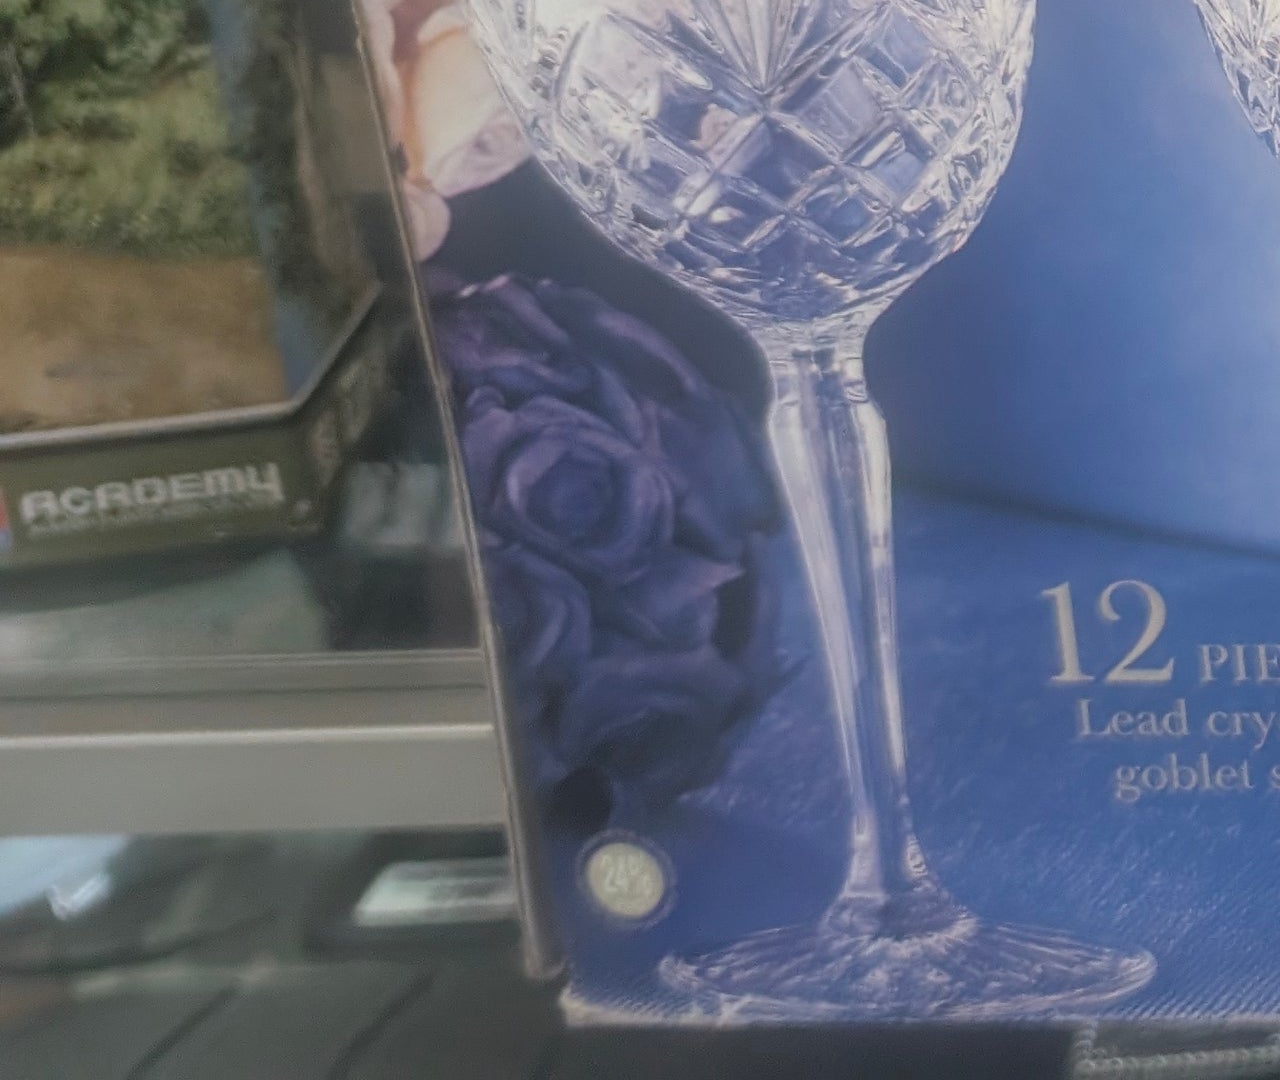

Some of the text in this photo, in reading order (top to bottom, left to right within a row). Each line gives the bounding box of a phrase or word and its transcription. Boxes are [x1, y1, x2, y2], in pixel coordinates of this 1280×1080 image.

[1040, 579, 1176, 683] 12
[1078, 697, 1191, 737] Lead
[1114, 752, 1256, 804] goblet
